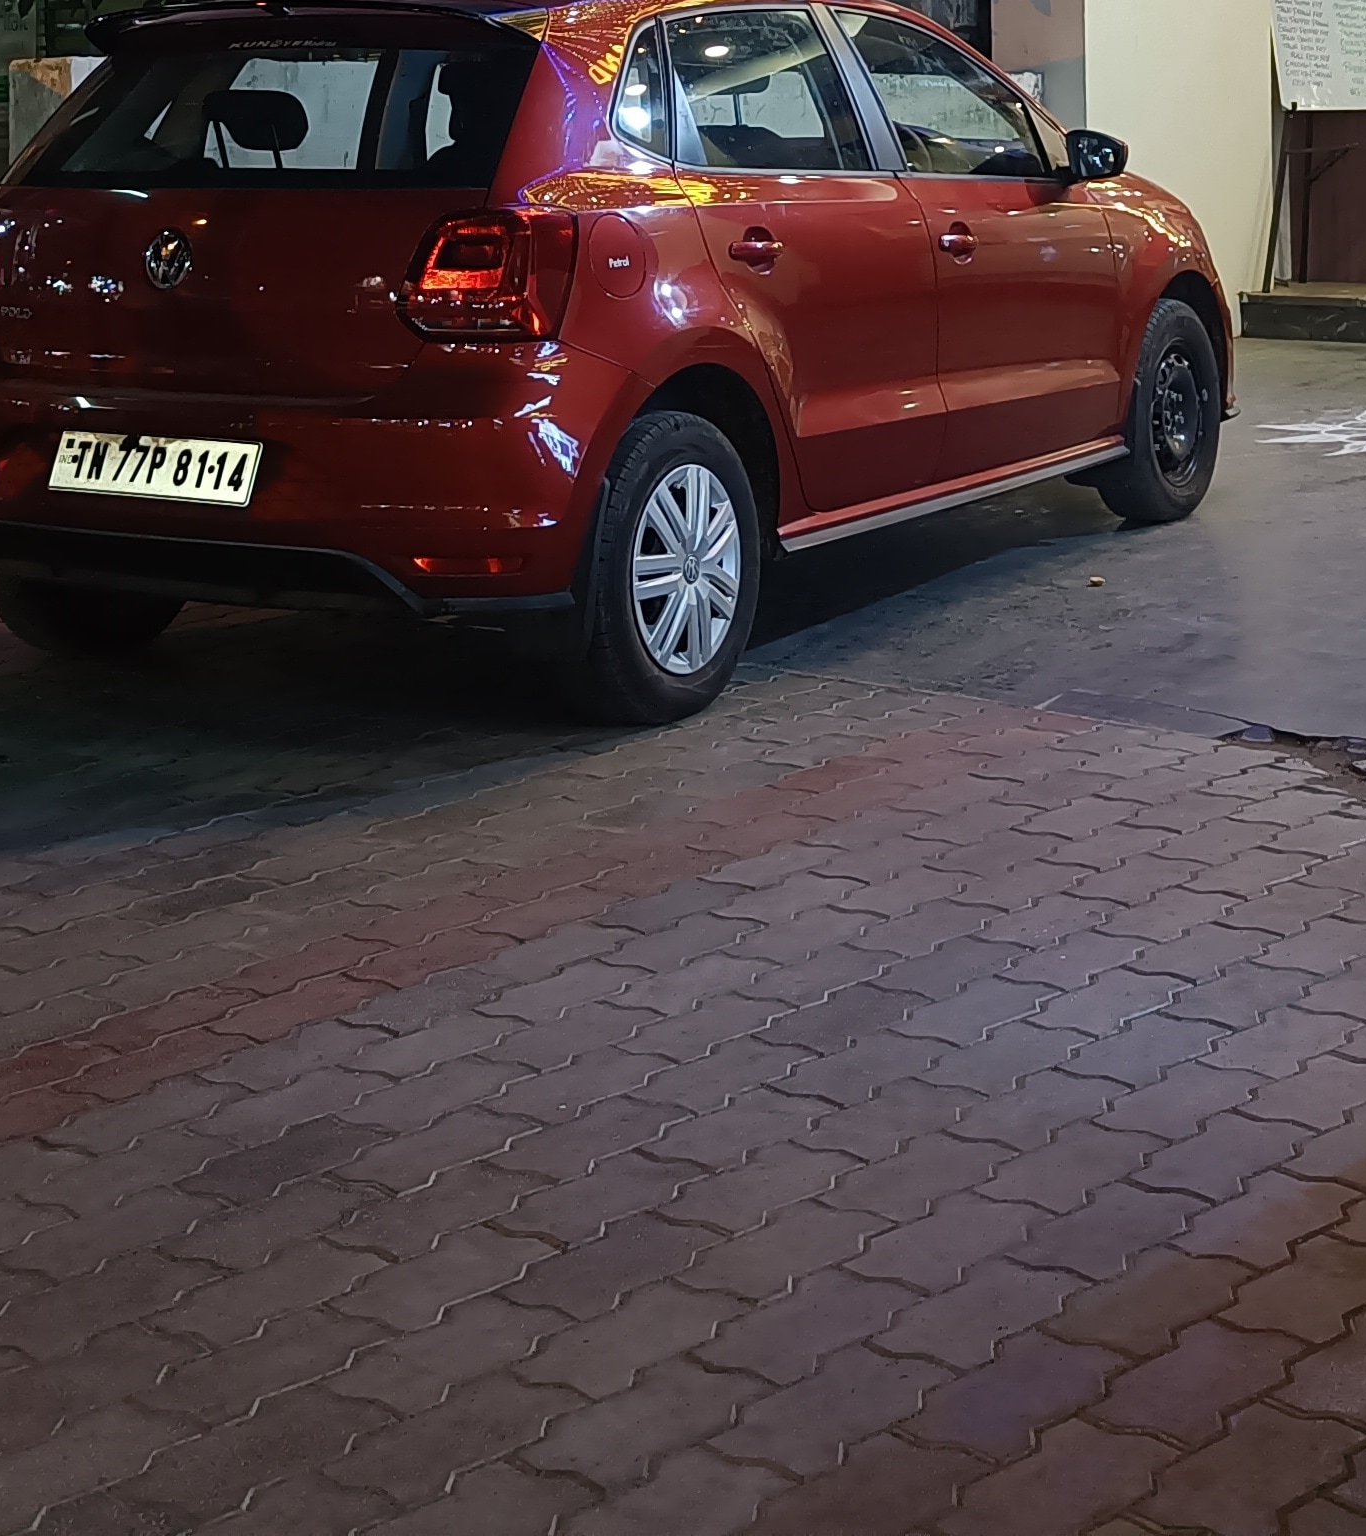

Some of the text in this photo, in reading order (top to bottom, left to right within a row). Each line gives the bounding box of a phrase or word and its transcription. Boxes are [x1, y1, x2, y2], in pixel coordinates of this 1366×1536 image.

[608, 255, 630, 269] Petrol
[0, 305, 34, 320] POLO
[74, 441, 110, 480] TN
[172, 448, 249, 492] 8114
